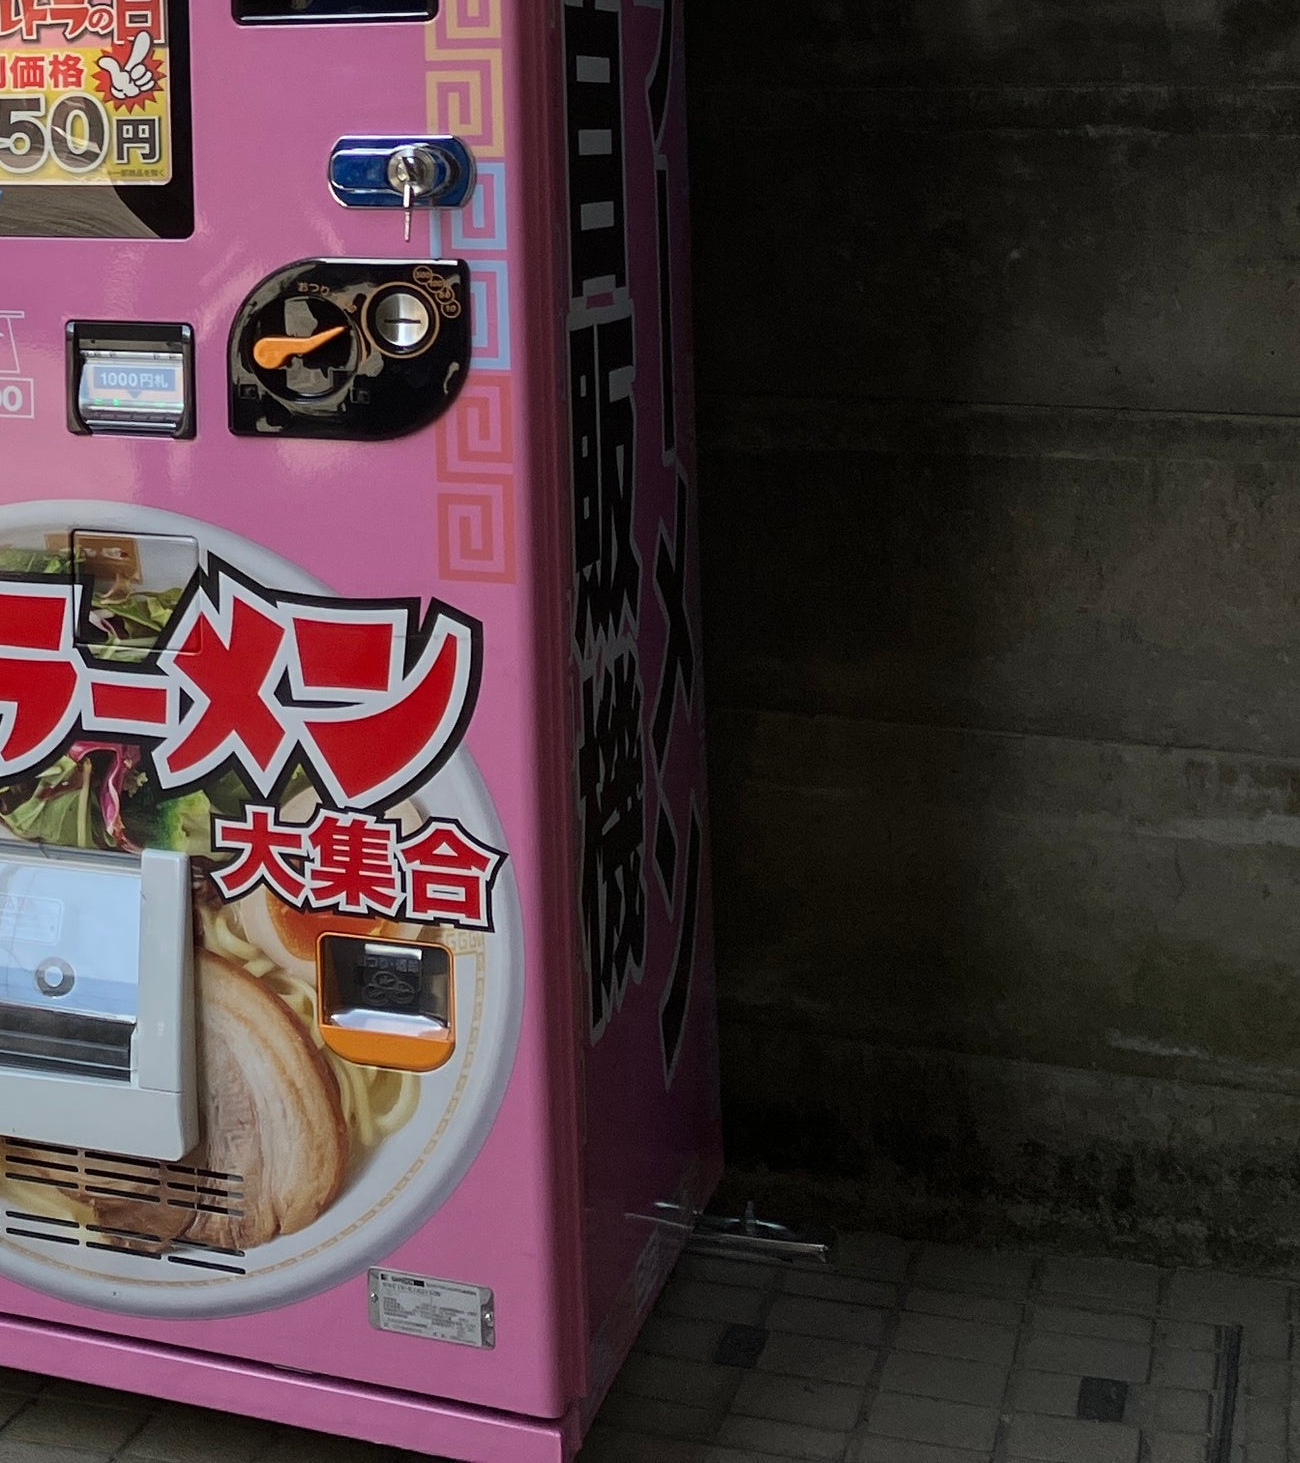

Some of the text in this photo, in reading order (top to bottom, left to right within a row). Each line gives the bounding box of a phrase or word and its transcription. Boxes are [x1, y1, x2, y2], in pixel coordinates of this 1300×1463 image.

[100, 373, 168, 388] 1000円札
[213, 802, 507, 932] 大集合
